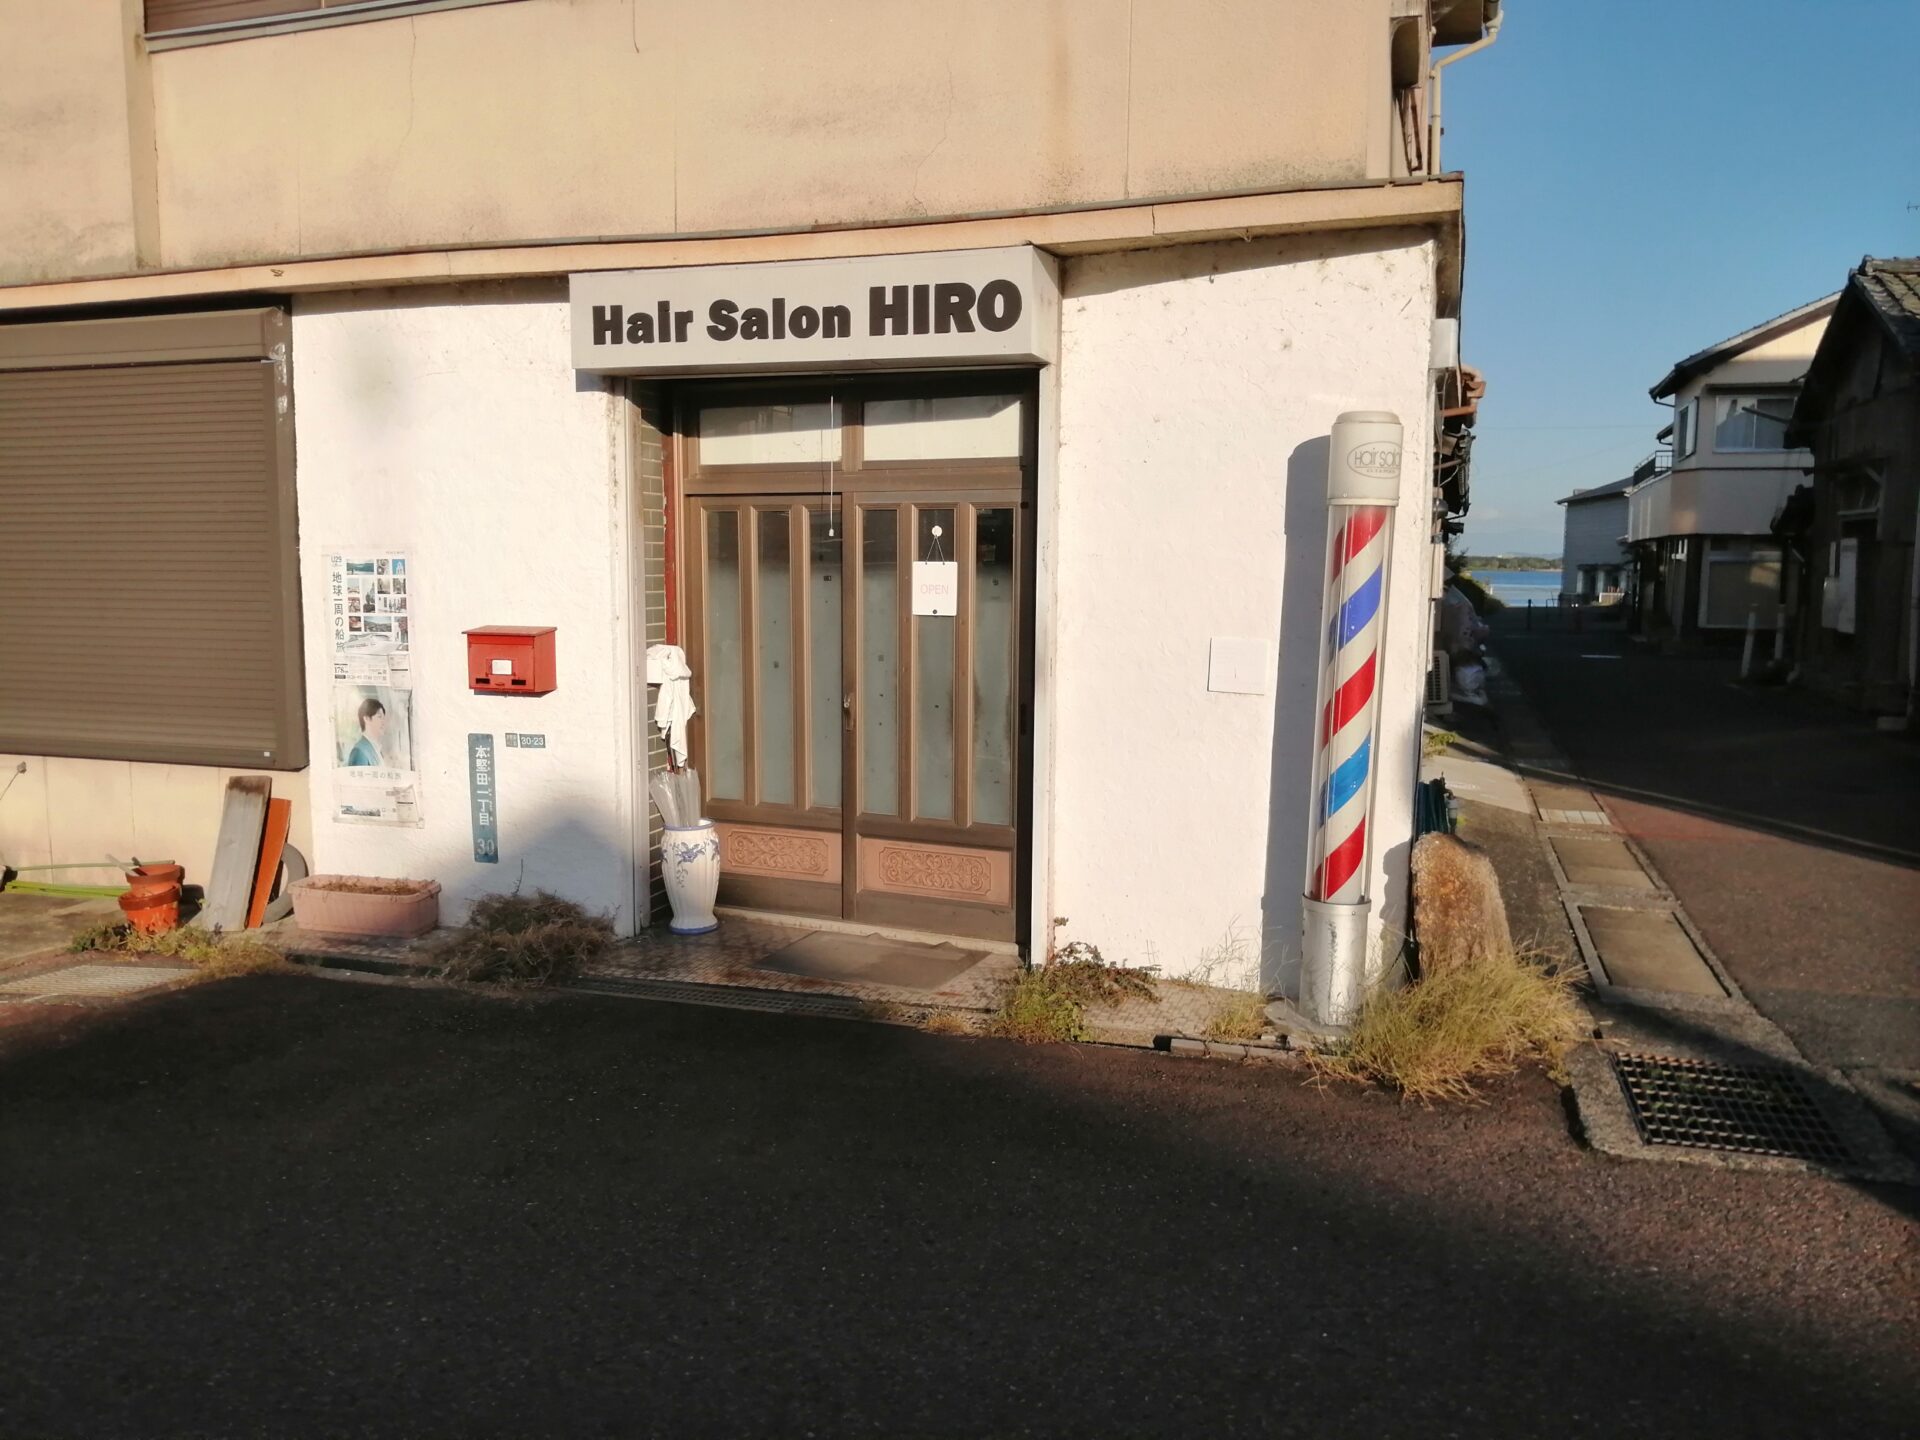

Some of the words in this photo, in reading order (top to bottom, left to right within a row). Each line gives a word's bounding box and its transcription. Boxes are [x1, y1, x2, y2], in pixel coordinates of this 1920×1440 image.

[592, 300, 694, 346] Hair
[705, 297, 852, 342] Salon
[868, 278, 1023, 337] HIRO
[332, 571, 345, 654] 地球一周の船旅
[920, 584, 949, 595] OPEN
[475, 745, 490, 826] 本堅田一丁目
[477, 838, 495, 855] 30
